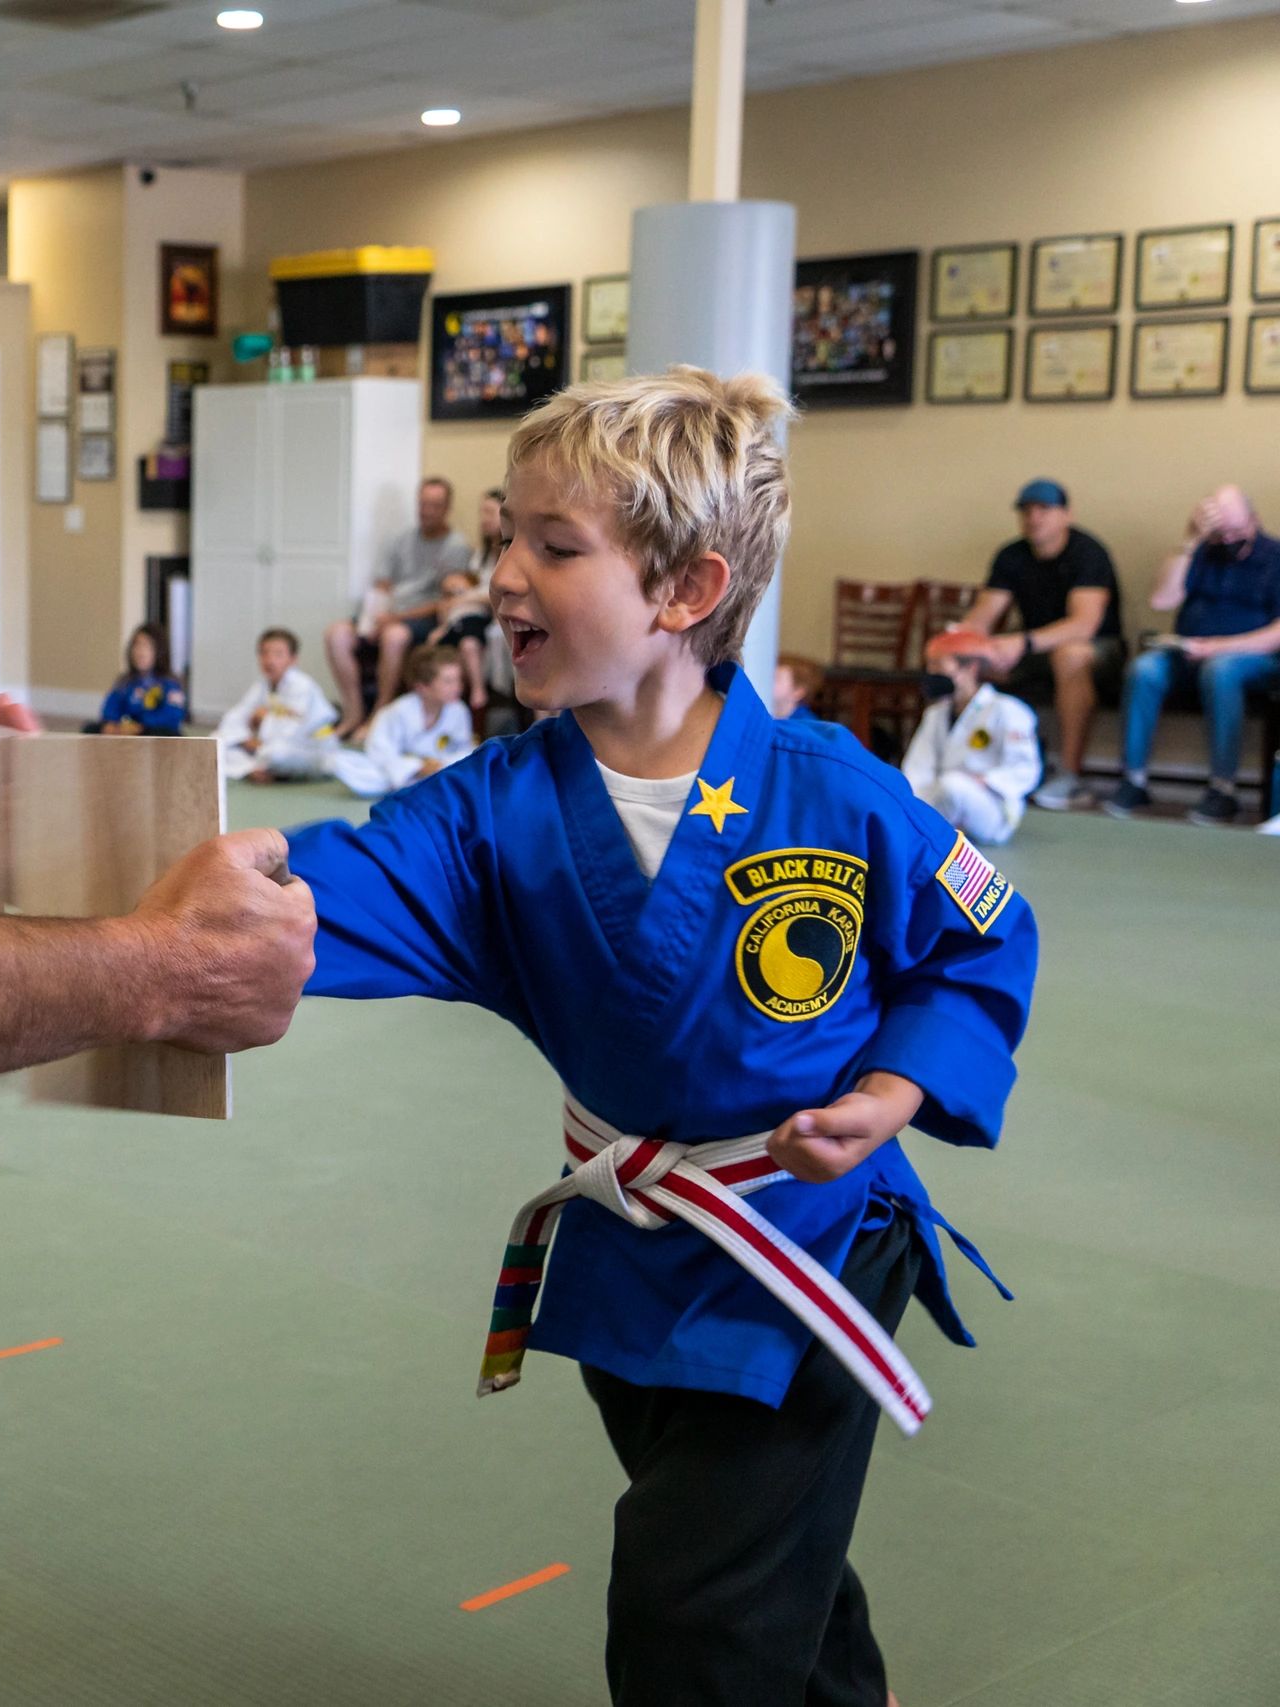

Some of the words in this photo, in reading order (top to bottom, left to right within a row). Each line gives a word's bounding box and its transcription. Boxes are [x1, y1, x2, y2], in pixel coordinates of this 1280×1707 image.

[746, 859, 809, 888] BLACK
[812, 859, 856, 886] BELT
[974, 885, 1001, 919] TANG
[745, 900, 821, 955] CALIFORNIA
[827, 906, 856, 955] KARATE
[765, 991, 828, 1014] ACADEMY
